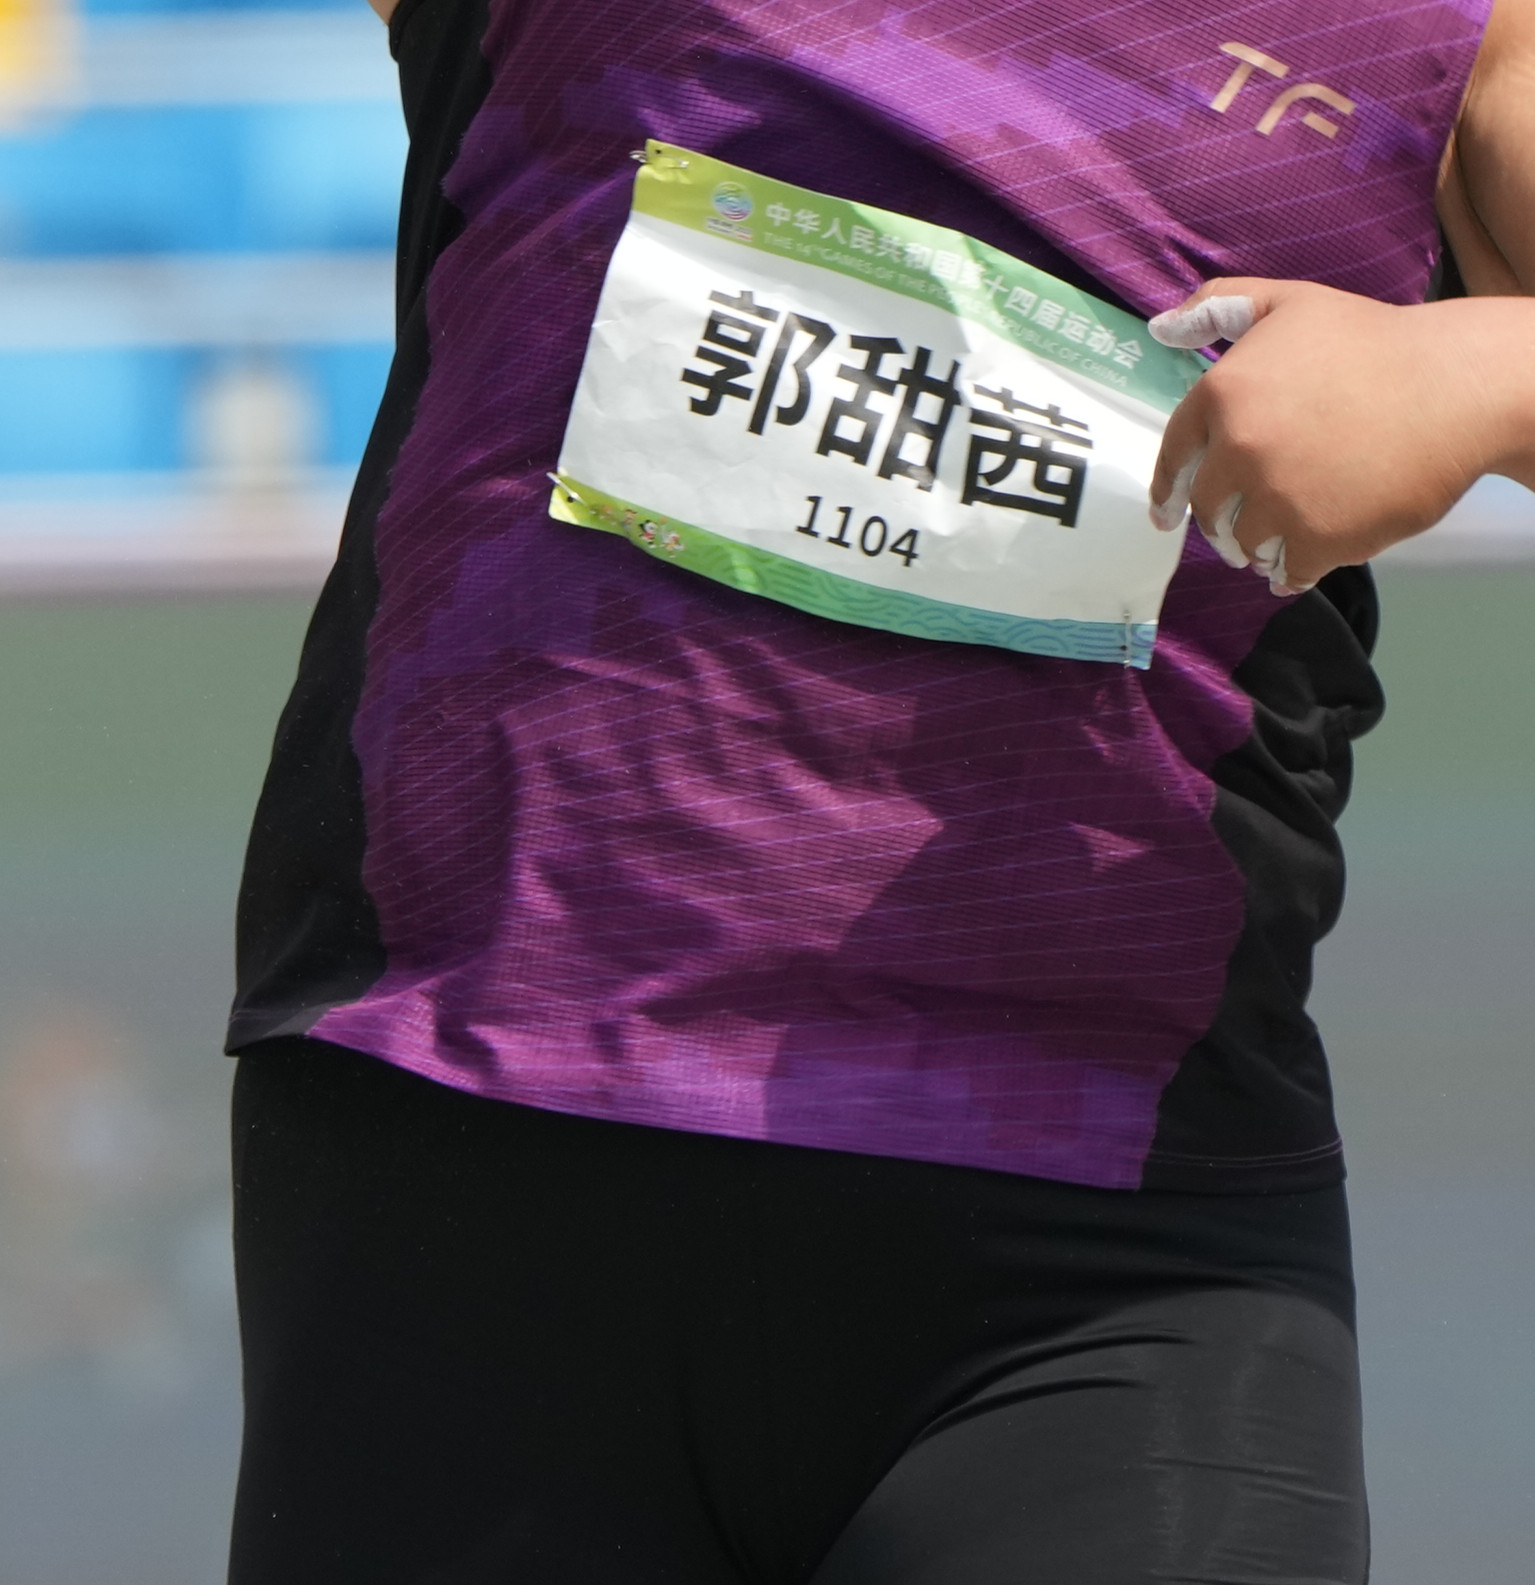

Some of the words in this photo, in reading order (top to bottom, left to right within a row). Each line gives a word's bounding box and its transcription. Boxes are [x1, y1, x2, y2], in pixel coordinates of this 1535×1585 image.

[766, 202, 1144, 369] 中华人民共和国第十四届运动会
[680, 289, 1095, 529] 郭甜茜
[1078, 355, 1129, 389] CHINA
[795, 495, 920, 567] 1104
